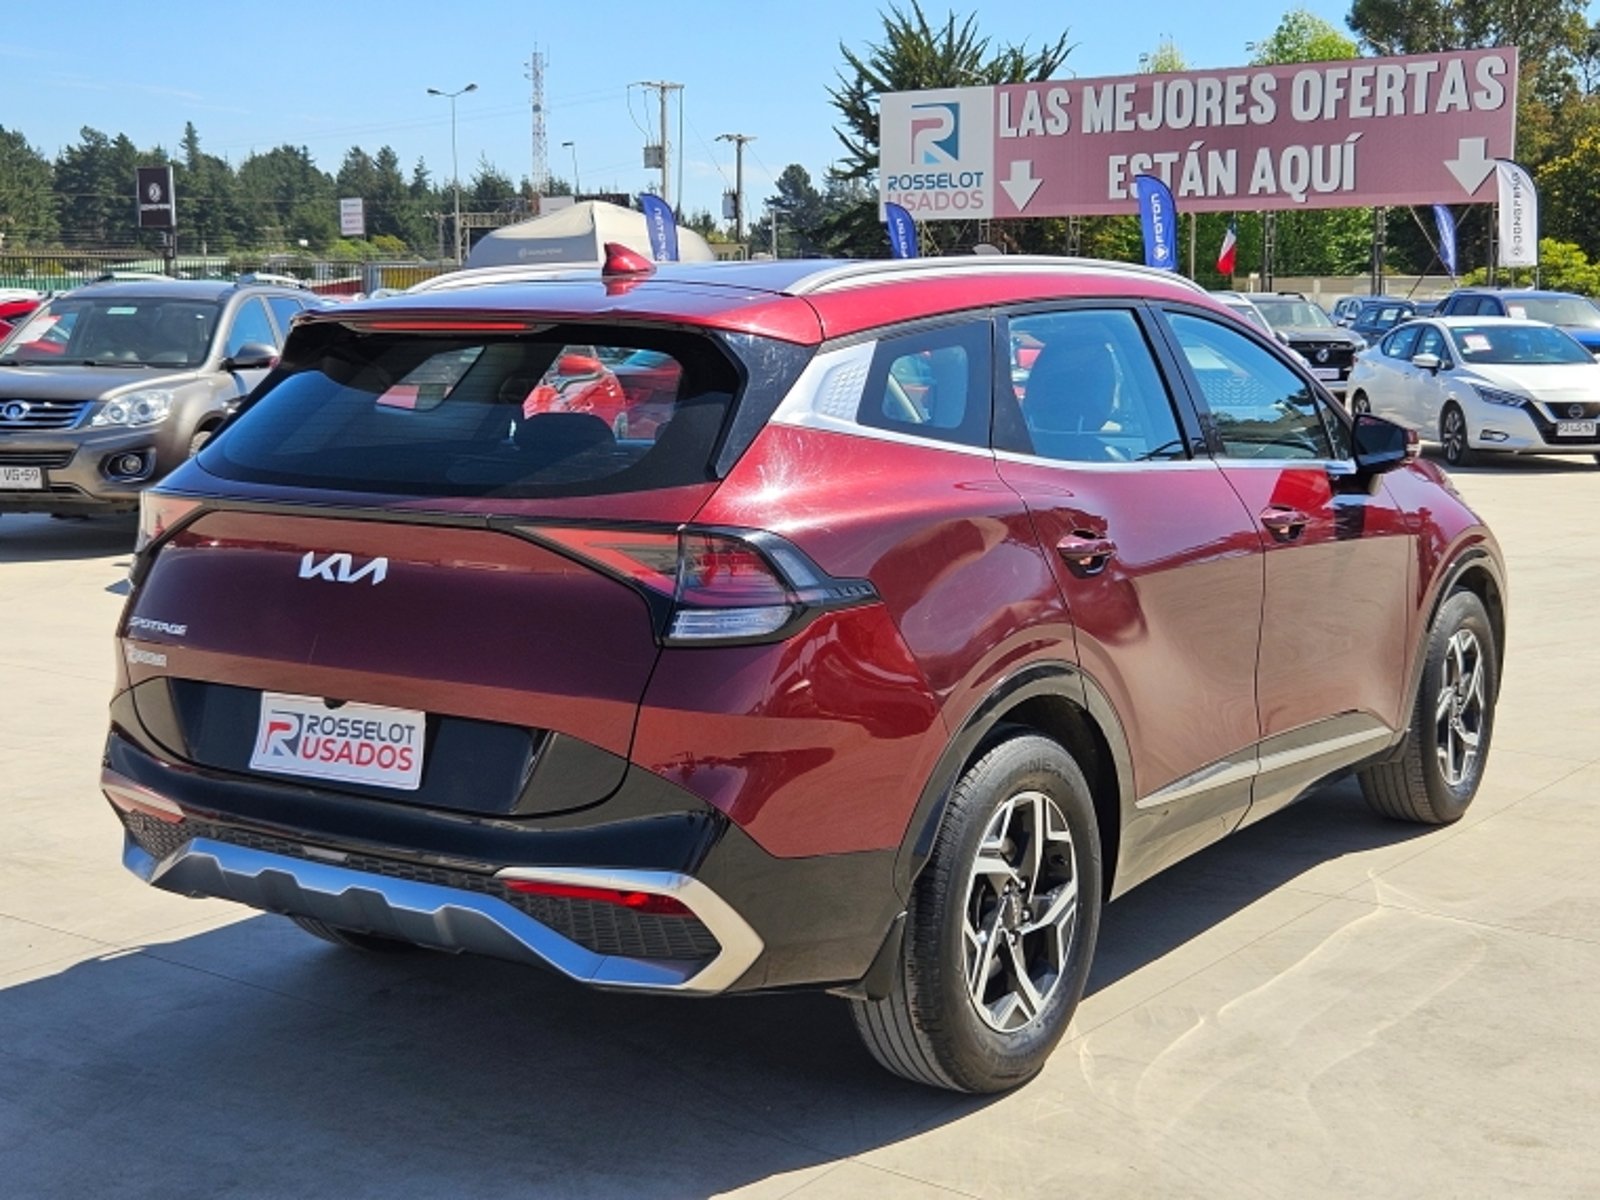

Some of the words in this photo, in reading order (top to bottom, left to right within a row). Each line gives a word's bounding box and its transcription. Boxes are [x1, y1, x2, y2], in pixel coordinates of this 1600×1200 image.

[1000, 88, 1070, 137] LAS
[1082, 73, 1277, 134] MEJORES
[1291, 56, 1508, 122] OFERTAS
[888, 172, 983, 191] ROSSELOT
[1109, 141, 1237, 200] ESTÁN
[1248, 132, 1364, 203] AQUÍ
[298, 550, 388, 586] KIA
[306, 715, 415, 744] ROSSELOT
[302, 737, 413, 771] USADOS
